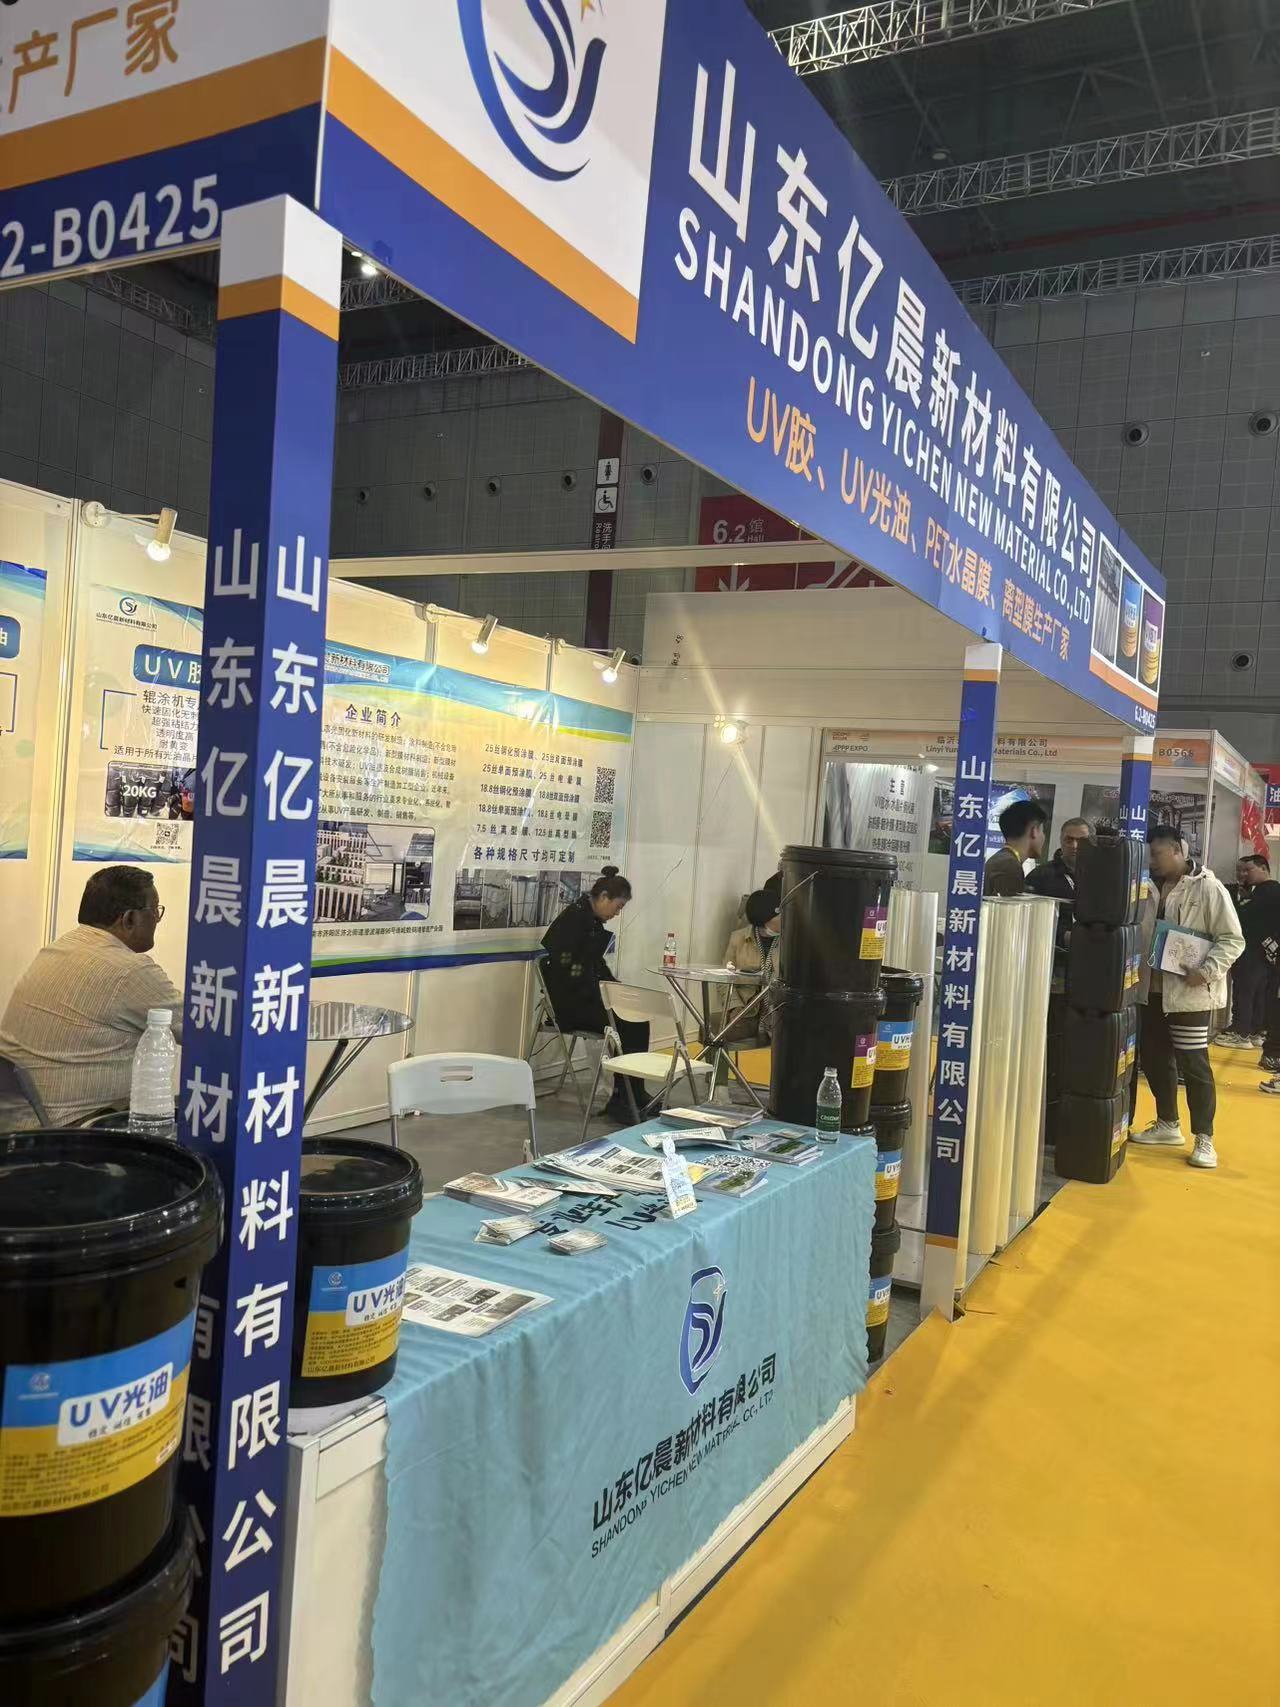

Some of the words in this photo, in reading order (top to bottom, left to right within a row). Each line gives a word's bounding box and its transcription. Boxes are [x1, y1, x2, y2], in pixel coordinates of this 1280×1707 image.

[688, 58, 1096, 589] 山东亿晨新材料有限公司
[674, 207, 875, 431] SHANDONG
[881, 392, 953, 505] YICHEN
[953, 471, 993, 538] NEW
[993, 507, 1052, 595] MATERIAL
[713, 519, 746, 544] 6.2
[749, 517, 765, 533] 馆
[345, 703, 401, 727] 企业简介
[122, 785, 157, 798] 20KG
[473, 846, 575, 864] 各种规格尺寸均可定制
[935, 755, 986, 1164] 山东亿晨新材料有限公司
[219, 535, 323, 1675] 山东亿晨新材料有限公司
[70, 1371, 168, 1427] UV光油
[592, 1352, 777, 1532] 山东亿晨新材料有限公司
